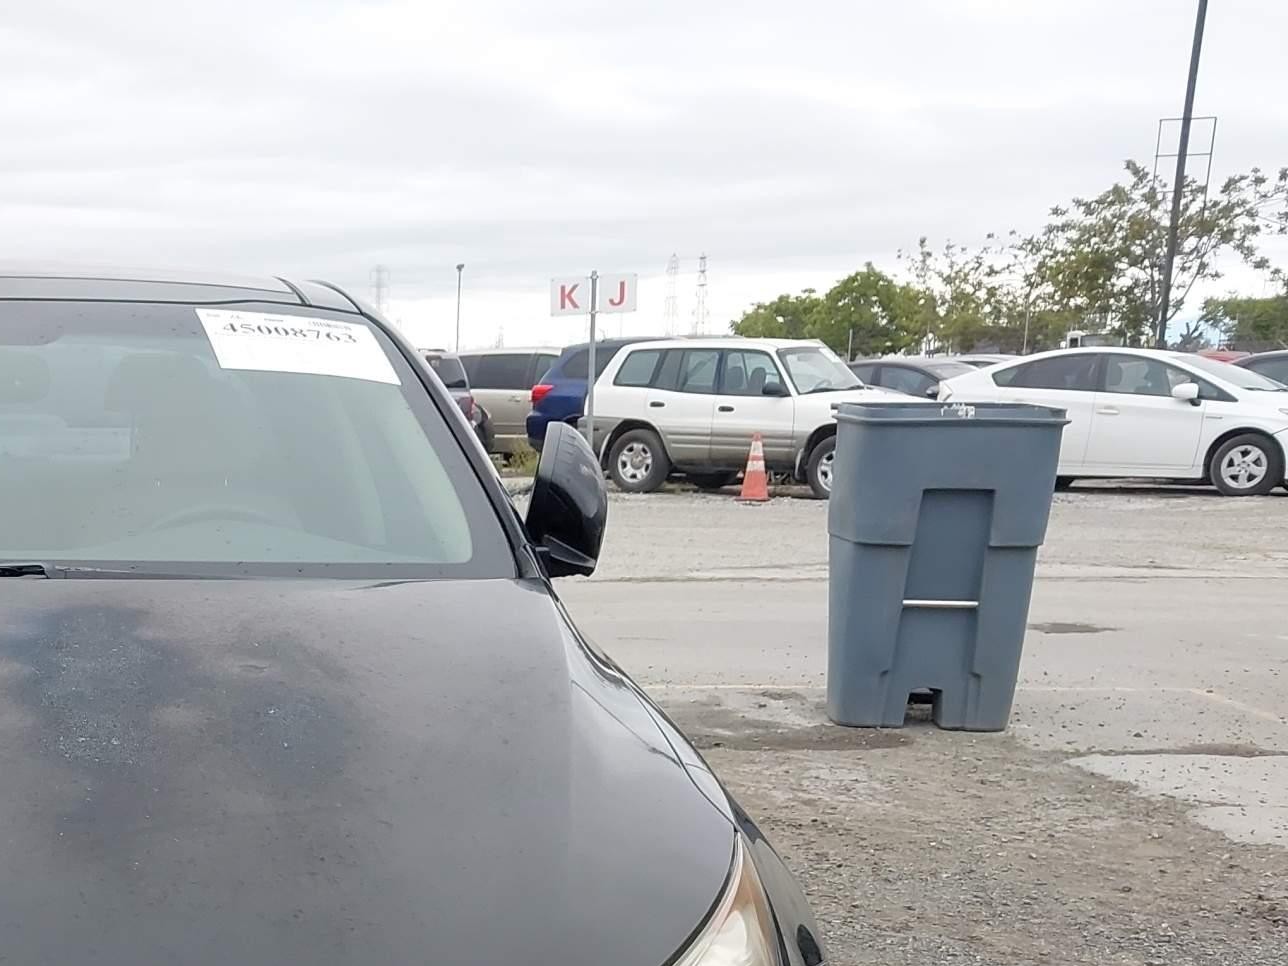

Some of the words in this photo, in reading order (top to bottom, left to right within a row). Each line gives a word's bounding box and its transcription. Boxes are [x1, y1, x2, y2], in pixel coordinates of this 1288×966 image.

[559, 283, 580, 310] K
[608, 280, 626, 307] J
[223, 322, 358, 343] 45008763
